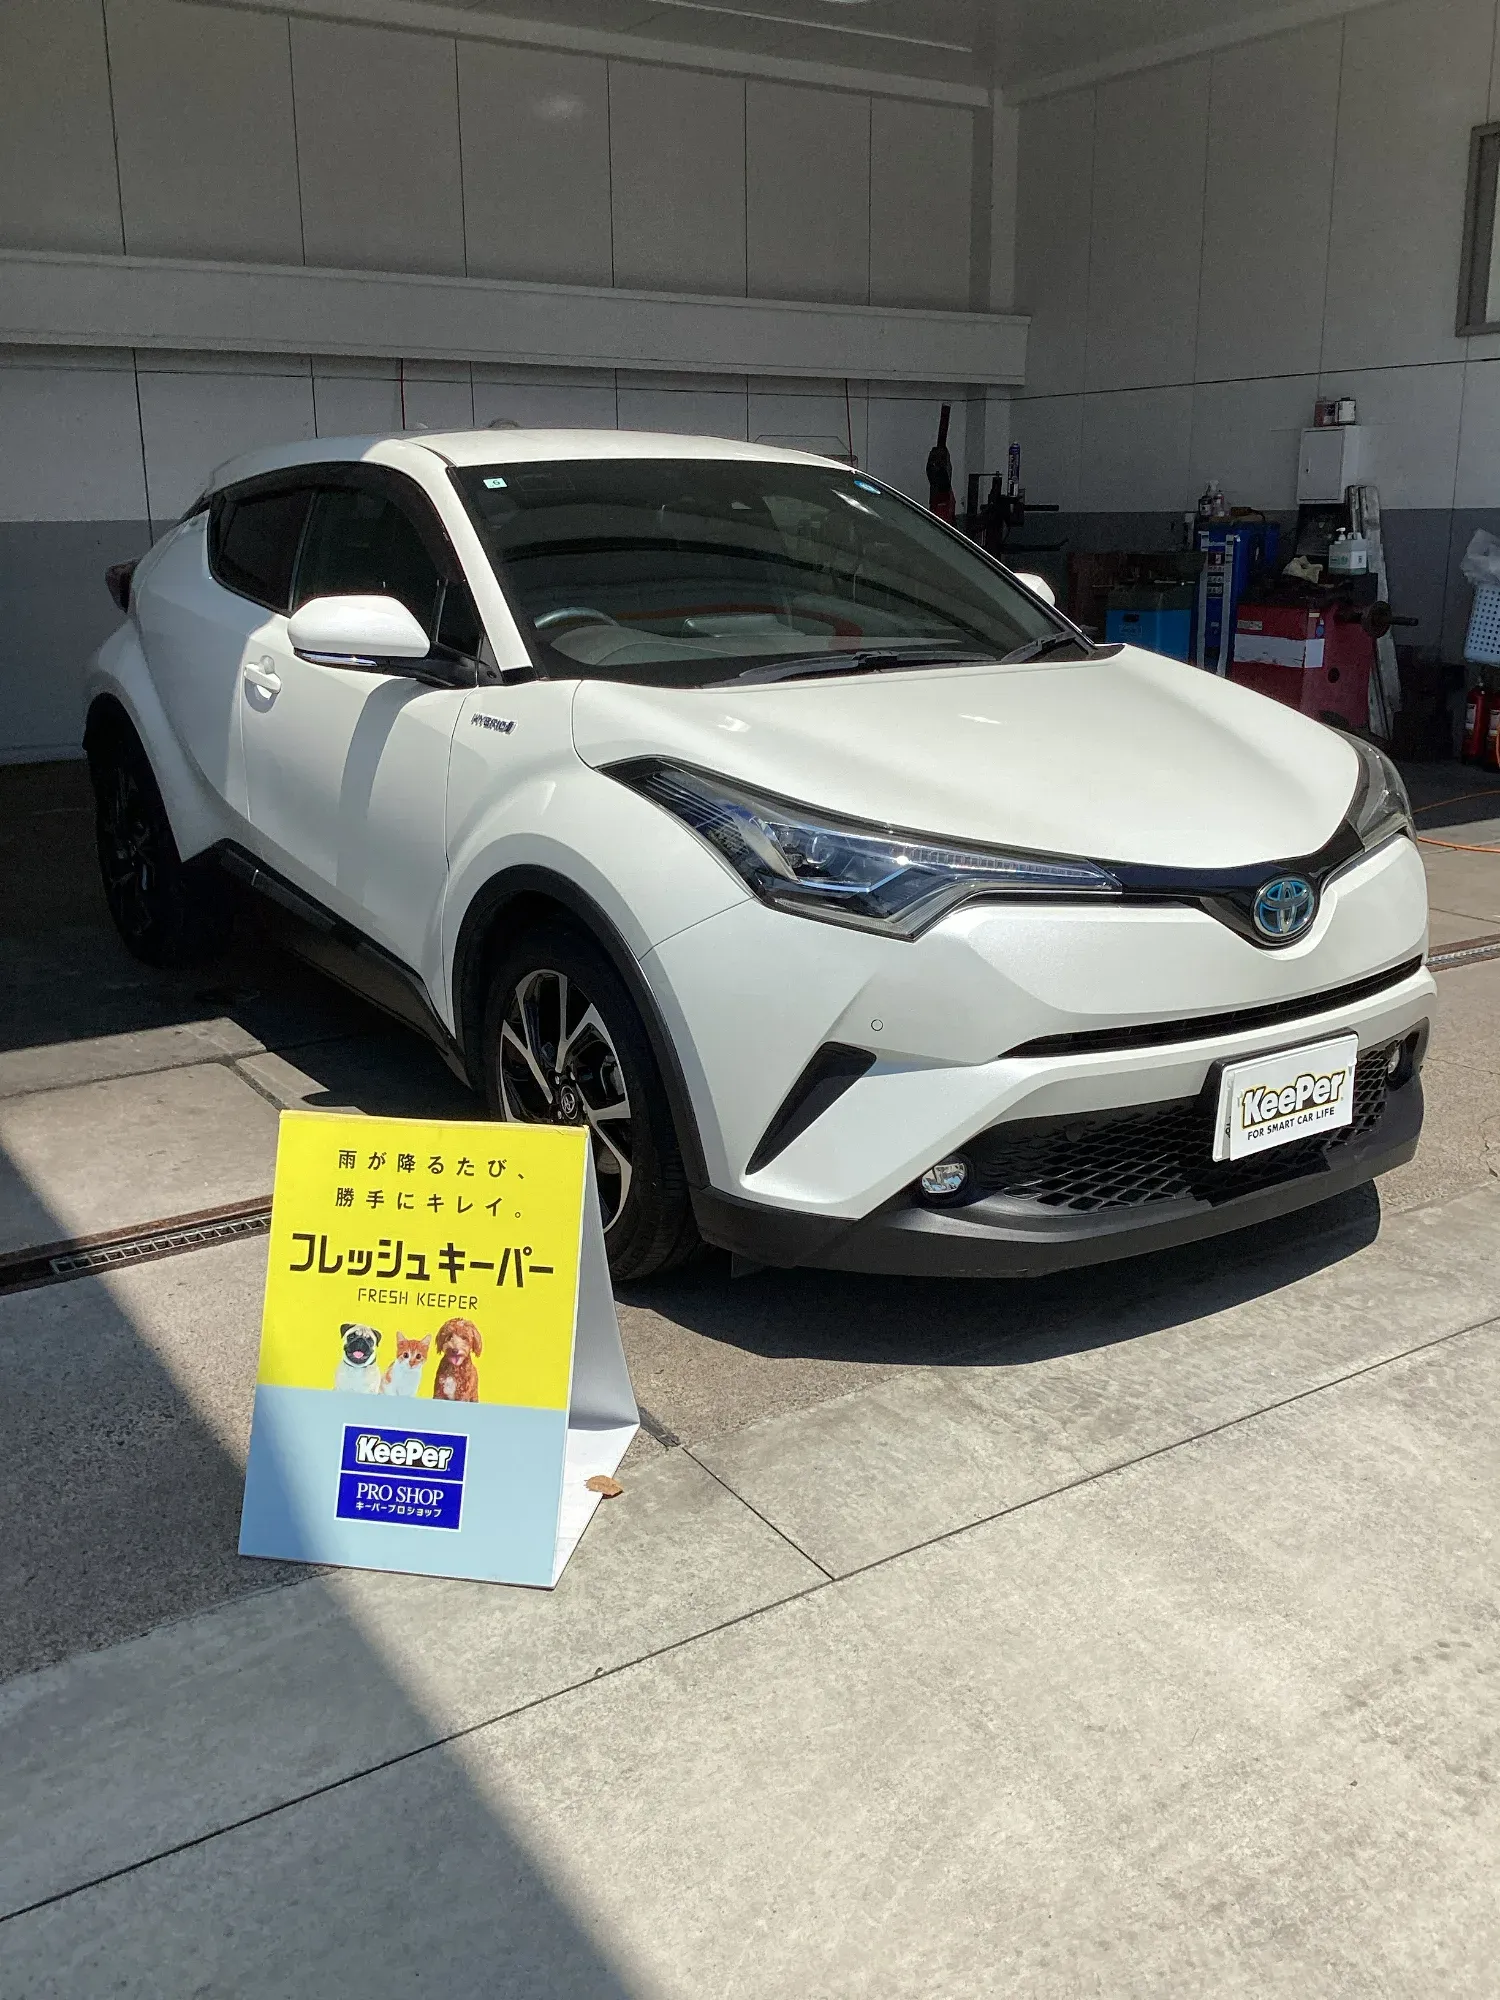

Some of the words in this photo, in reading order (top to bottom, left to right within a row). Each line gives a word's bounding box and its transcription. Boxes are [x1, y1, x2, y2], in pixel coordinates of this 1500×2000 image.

[1241, 1071, 1346, 1129] KeePer
[1247, 1129, 1265, 1141] FOR
[1266, 1119, 1295, 1135] SMART
[1297, 1112, 1314, 1125] CAR
[1316, 1107, 1335, 1119] LIFE
[337, 1149, 525, 1180] 雨が降るたび、
[334, 1187, 522, 1219] 勝手にキレイ。
[290, 1233, 554, 1288] フレッシュキーパー
[357, 1288, 409, 1305] FRESH
[416, 1292, 479, 1310] KEEPER
[356, 1434, 454, 1471] KeePer
[356, 1482, 393, 1501] PRO
[395, 1486, 444, 1506] SHOP
